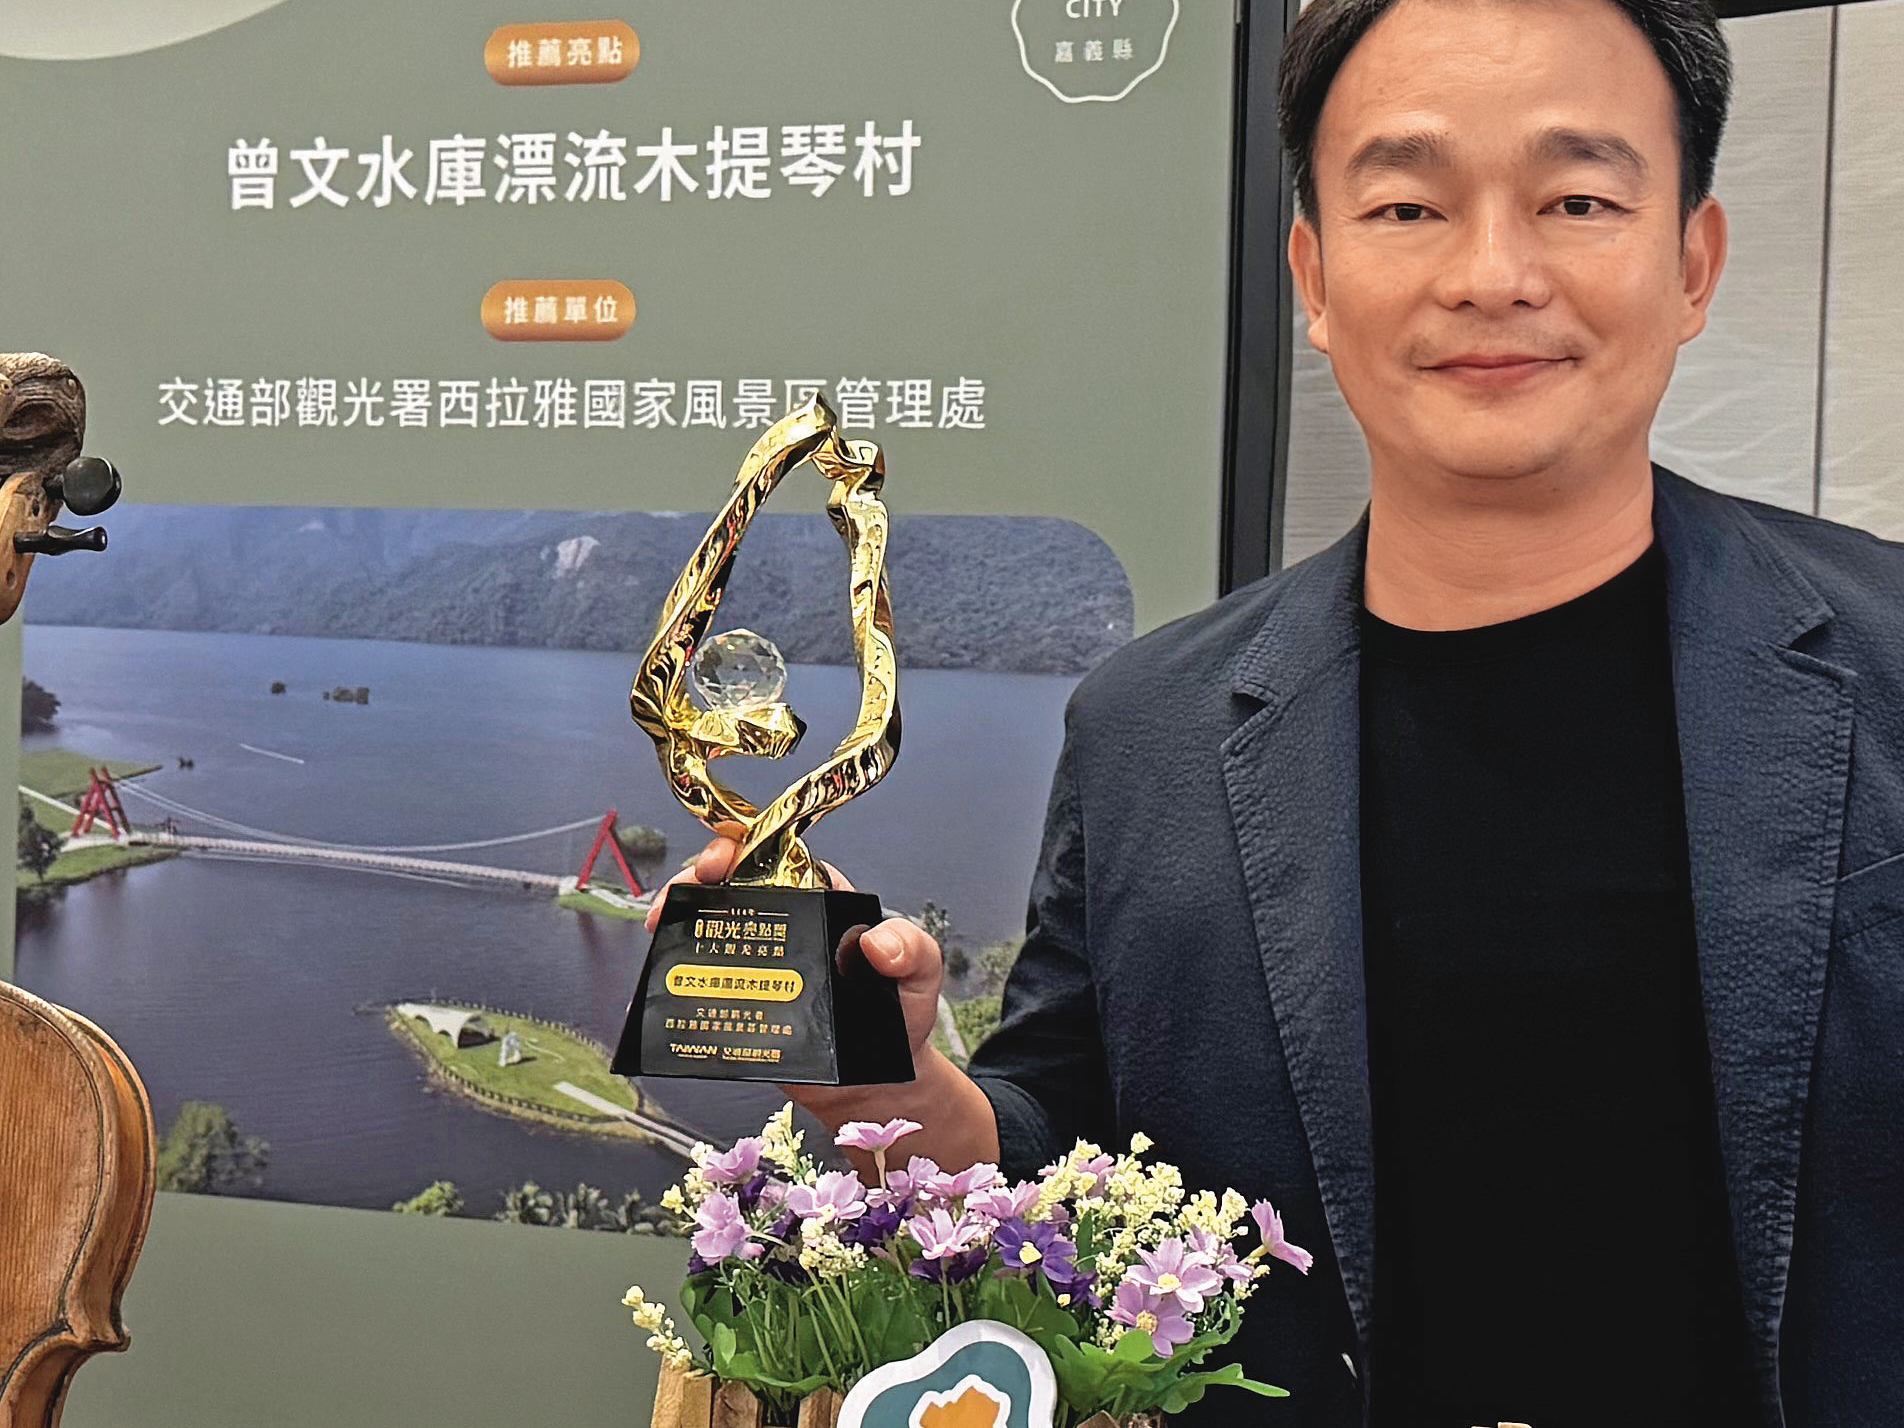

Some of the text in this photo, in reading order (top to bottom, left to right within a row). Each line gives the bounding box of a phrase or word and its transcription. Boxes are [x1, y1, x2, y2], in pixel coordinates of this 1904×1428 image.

[508, 36, 622, 67] 推薦亮點
[225, 119, 922, 212] 曾文水庫漂流木提琴村
[504, 295, 618, 323] 推薦單位
[670, 1043, 717, 1055] TAIWAN
